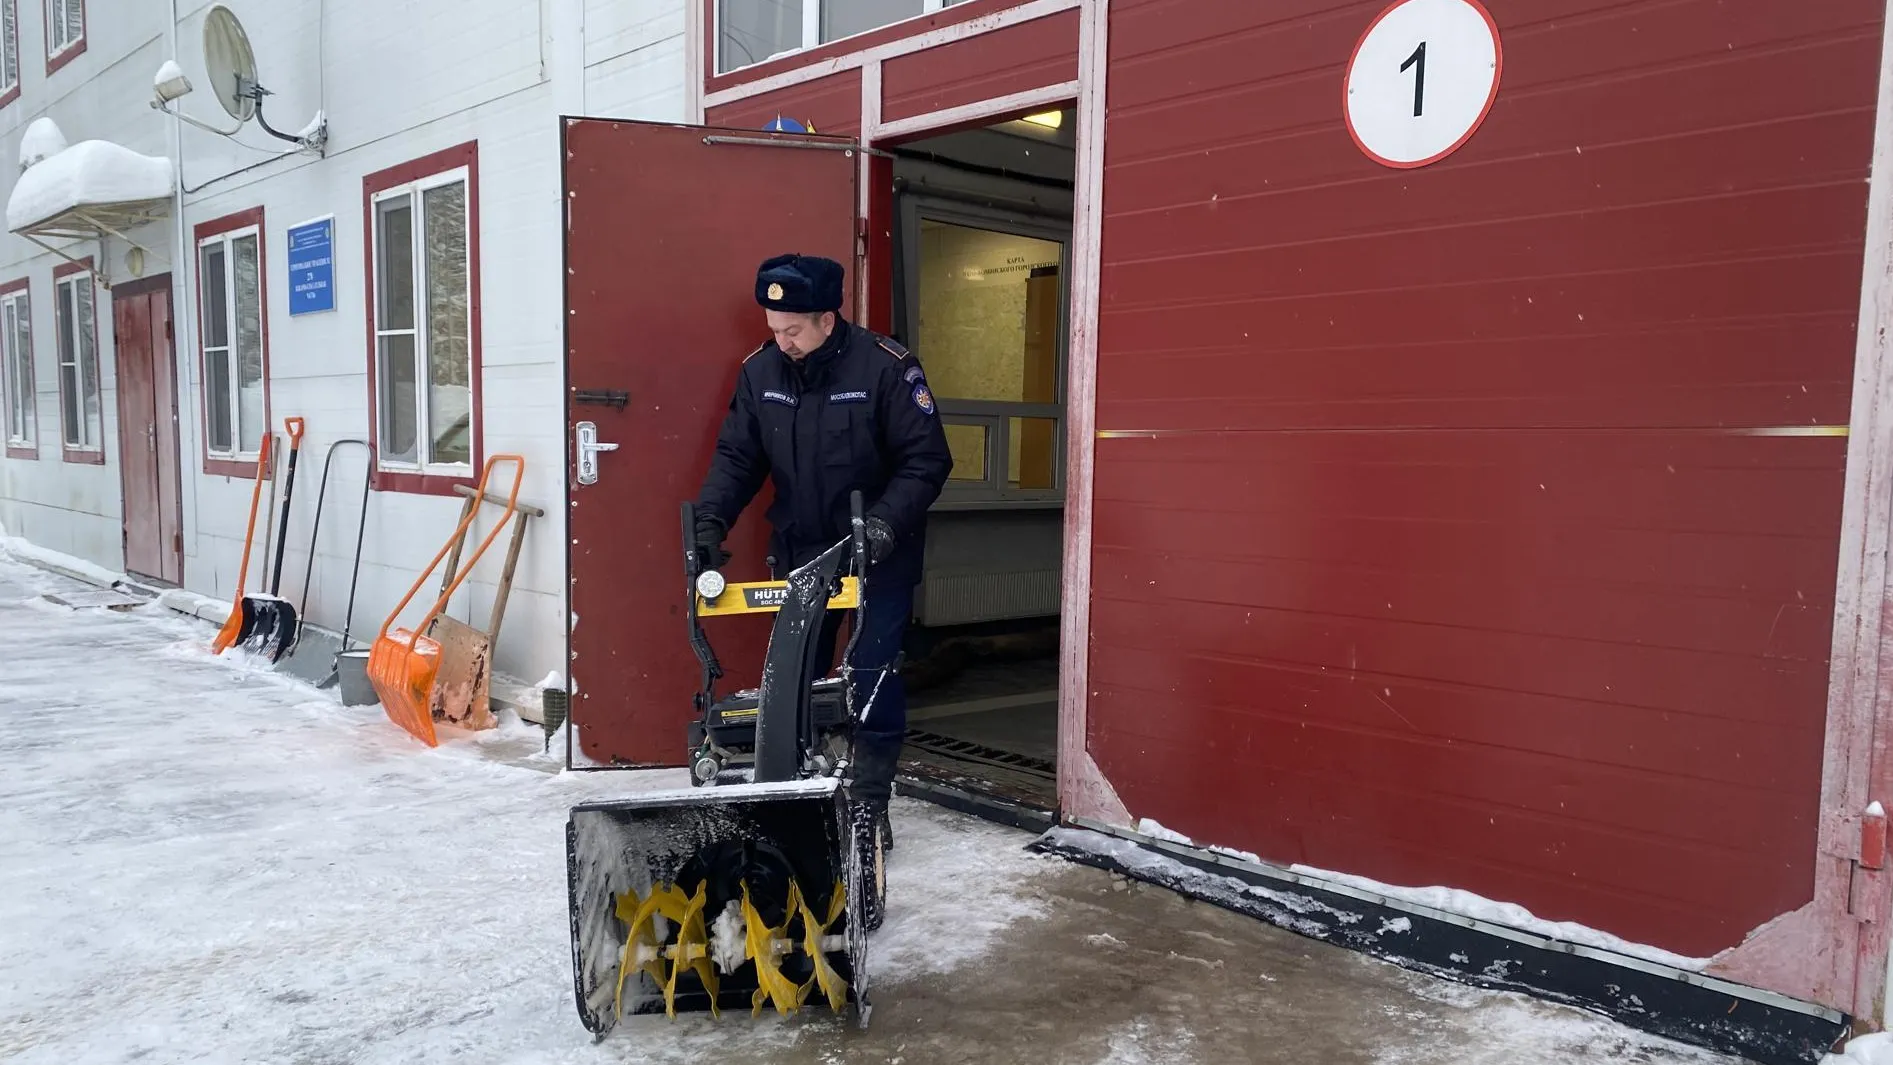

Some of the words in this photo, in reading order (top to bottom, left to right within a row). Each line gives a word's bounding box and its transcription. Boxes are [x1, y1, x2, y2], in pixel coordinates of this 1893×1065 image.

[1400, 41, 1426, 117] 1
[1007, 256, 1025, 264] КАРТА
[754, 589, 788, 599] HÜTE
